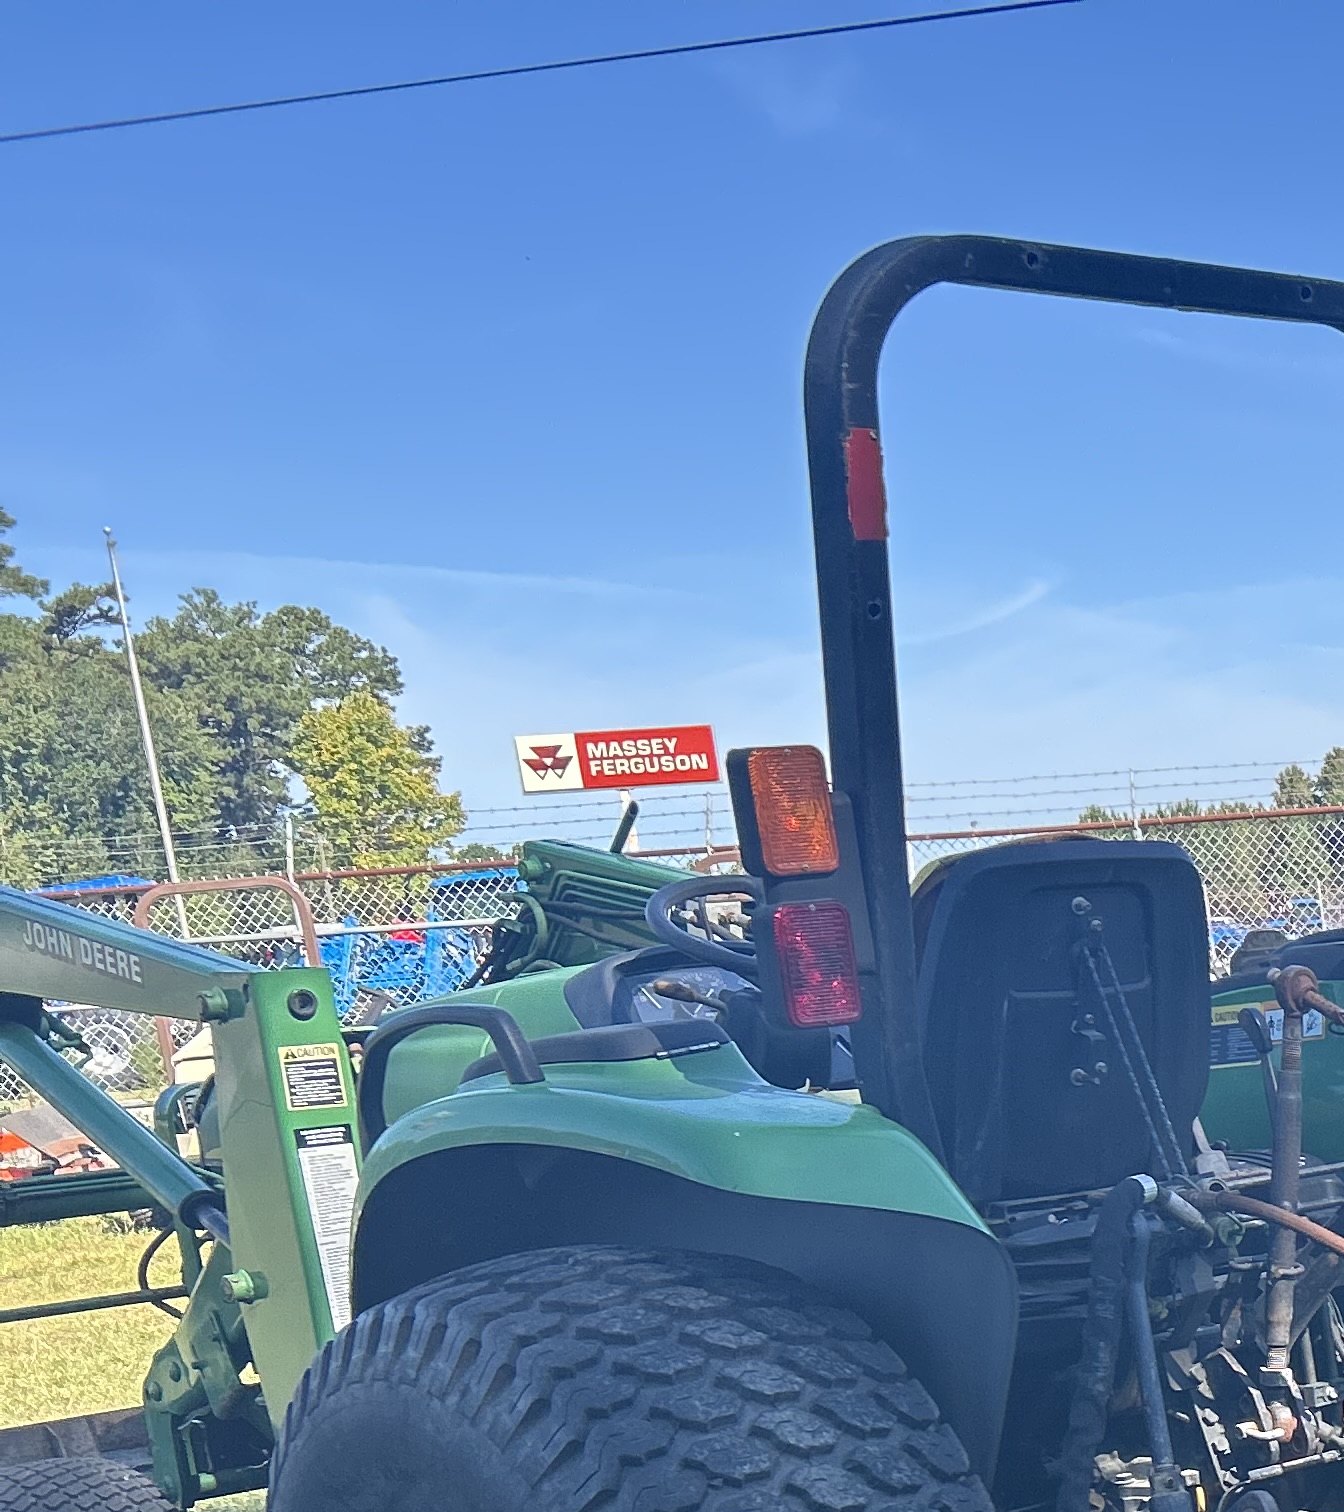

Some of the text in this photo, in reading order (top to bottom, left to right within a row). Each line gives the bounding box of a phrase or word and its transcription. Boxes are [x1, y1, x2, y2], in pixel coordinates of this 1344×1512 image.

[586, 737, 678, 759] MASSEY
[589, 753, 709, 777] FERGUSON
[22, 920, 143, 984] JOHN DEERE
[296, 1046, 336, 1057] CAUTION
